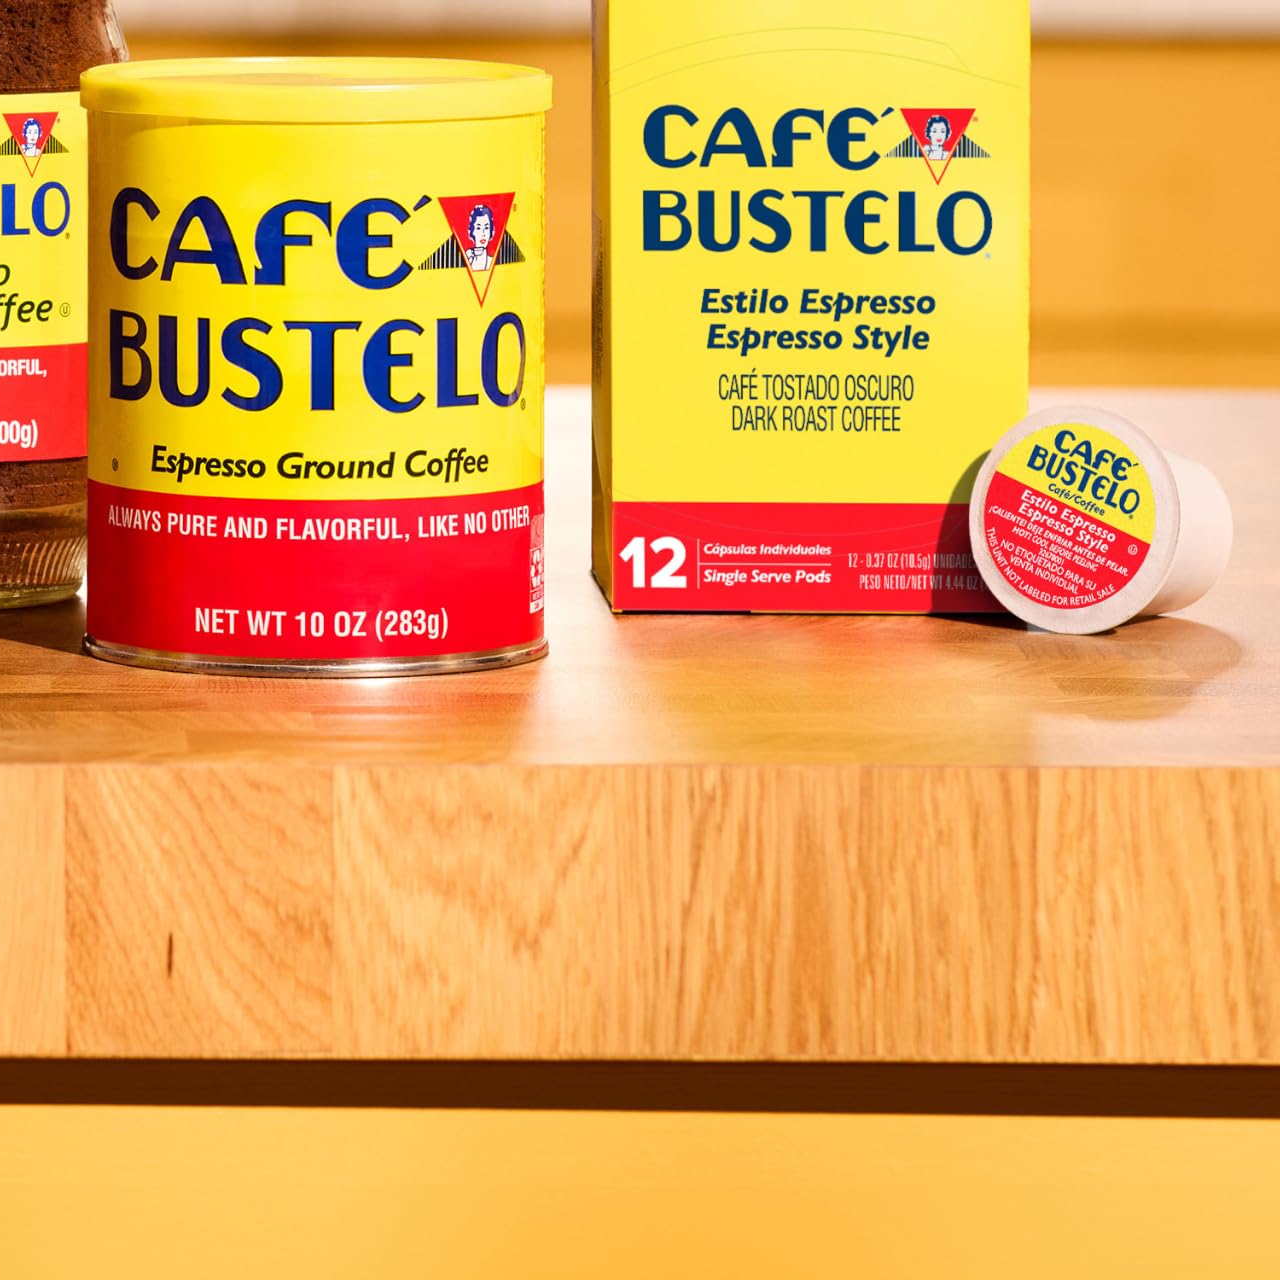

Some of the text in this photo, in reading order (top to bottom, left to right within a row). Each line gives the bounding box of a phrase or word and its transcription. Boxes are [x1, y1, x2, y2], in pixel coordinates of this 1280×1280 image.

[643, 104, 895, 171] CAFÉ
[109, 186, 433, 290] CAFÉ
[642, 188, 993, 256] BUSTELO
[700, 288, 936, 322] Estilo Espresso
[706, 324, 930, 357] Espresso Style
[109, 308, 526, 414] BUSTELO
[718, 368, 915, 402] CAFÉ TOSTADO OSCURO
[731, 405, 901, 432] DARK ROAST COFFEE
[151, 444, 489, 483] Espresso Ground Coffee
[1027, 444, 1140, 514] BUSTELO
[1021, 489, 1116, 542] Estilo Espresso
[1048, 483, 1105, 516] Café/Coffee
[108, 504, 161, 532] ALWAYS
[167, 512, 218, 537] PURE
[224, 517, 268, 539] AND
[276, 517, 410, 543] FLAVORFUL,
[418, 514, 459, 538] LIKE
[464, 511, 487, 535] NO
[491, 505, 530, 532] OTHER
[986, 526, 999, 547] THIS
[1018, 502, 1109, 553] Espresso Style
[703, 543, 832, 558] Cápsulas Individuales
[848, 552, 858, 568] 12
[866, 552, 885, 568] 0.37
[887, 553, 899, 568] OZ
[992, 546, 1008, 567] UNIT
[1012, 526, 1099, 572] HOT! COOL BEFORE PEELING
[1027, 522, 1044, 535] DEJE
[1043, 530, 1073, 549] ENFRIAR
[1072, 545, 1096, 560] ANTES
[1095, 555, 1107, 566] DE
[619, 536, 687, 589] 12
[703, 569, 832, 587] Single Serve Pods
[1000, 539, 1097, 591] NO ETIQUETADO PARA SU
[1003, 566, 1021, 584] NOT
[1010, 554, 1079, 595] VENTA INDIVIDUAL
[859, 574, 881, 589] PESO
[883, 574, 927, 590] NETO/NET
[929, 575, 943, 590] WT
[945, 575, 965, 590] 4.44
[1018, 580, 1051, 602] LABELED
[1069, 593, 1097, 605] RETAIL
[1096, 583, 1116, 599] SALE
[1051, 595, 1069, 606] FOR
[194, 607, 449, 642] NET WT 10 OZ (283g)
